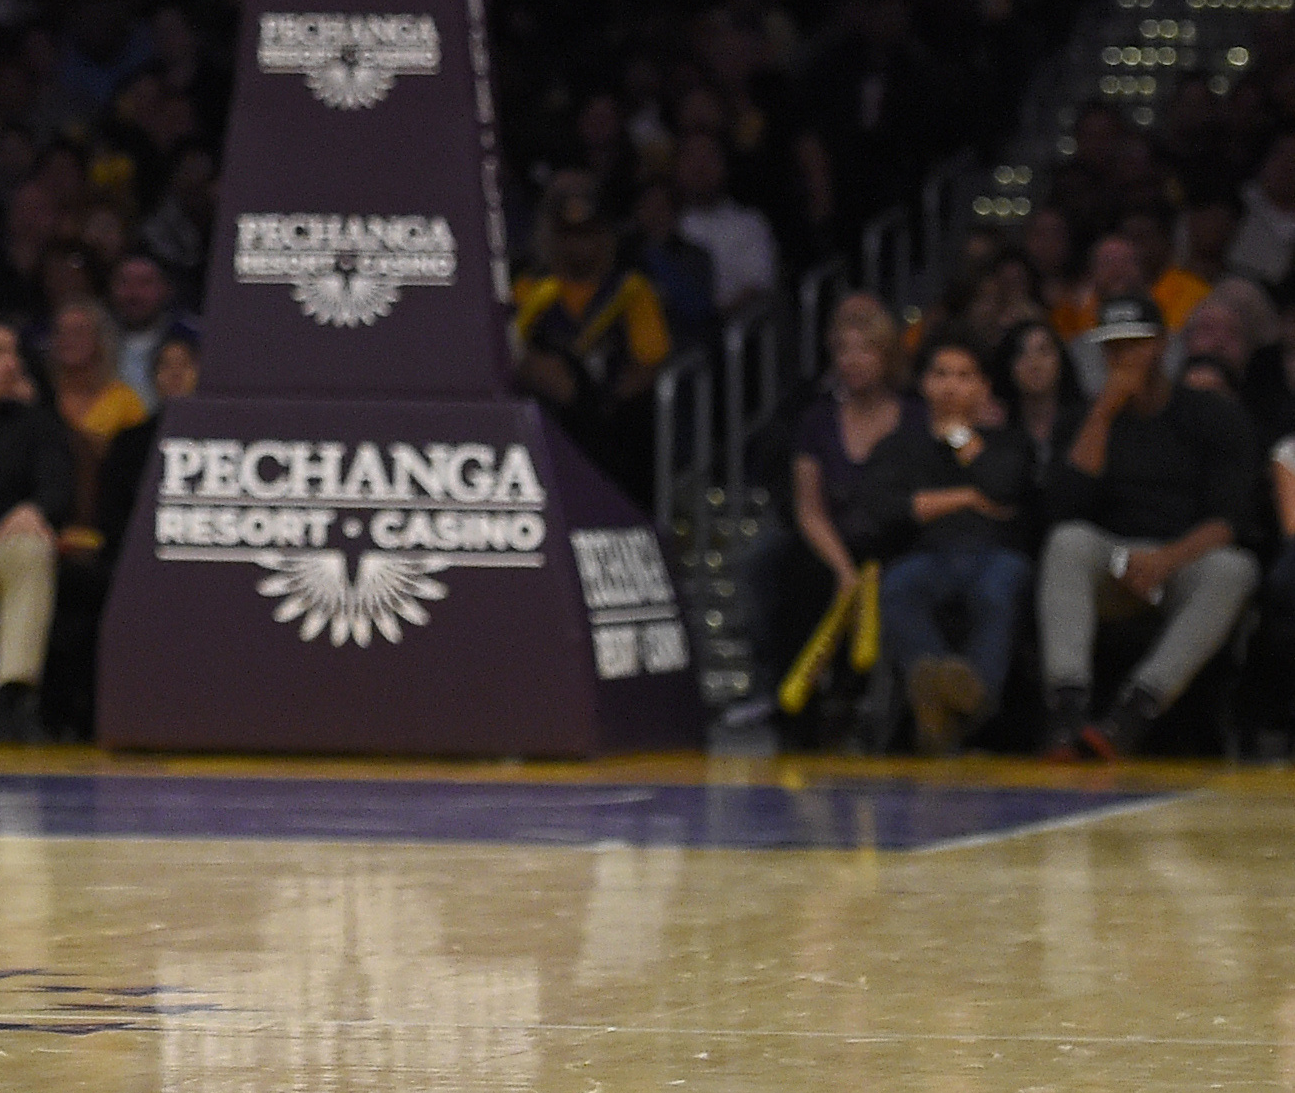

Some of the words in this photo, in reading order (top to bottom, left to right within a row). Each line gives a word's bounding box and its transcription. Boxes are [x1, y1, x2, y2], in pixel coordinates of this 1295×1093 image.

[235, 212, 456, 251] PECHANGA
[157, 438, 547, 503] PECHANGA
[156, 507, 338, 548] RESORT
[369, 508, 547, 552] CASINO
